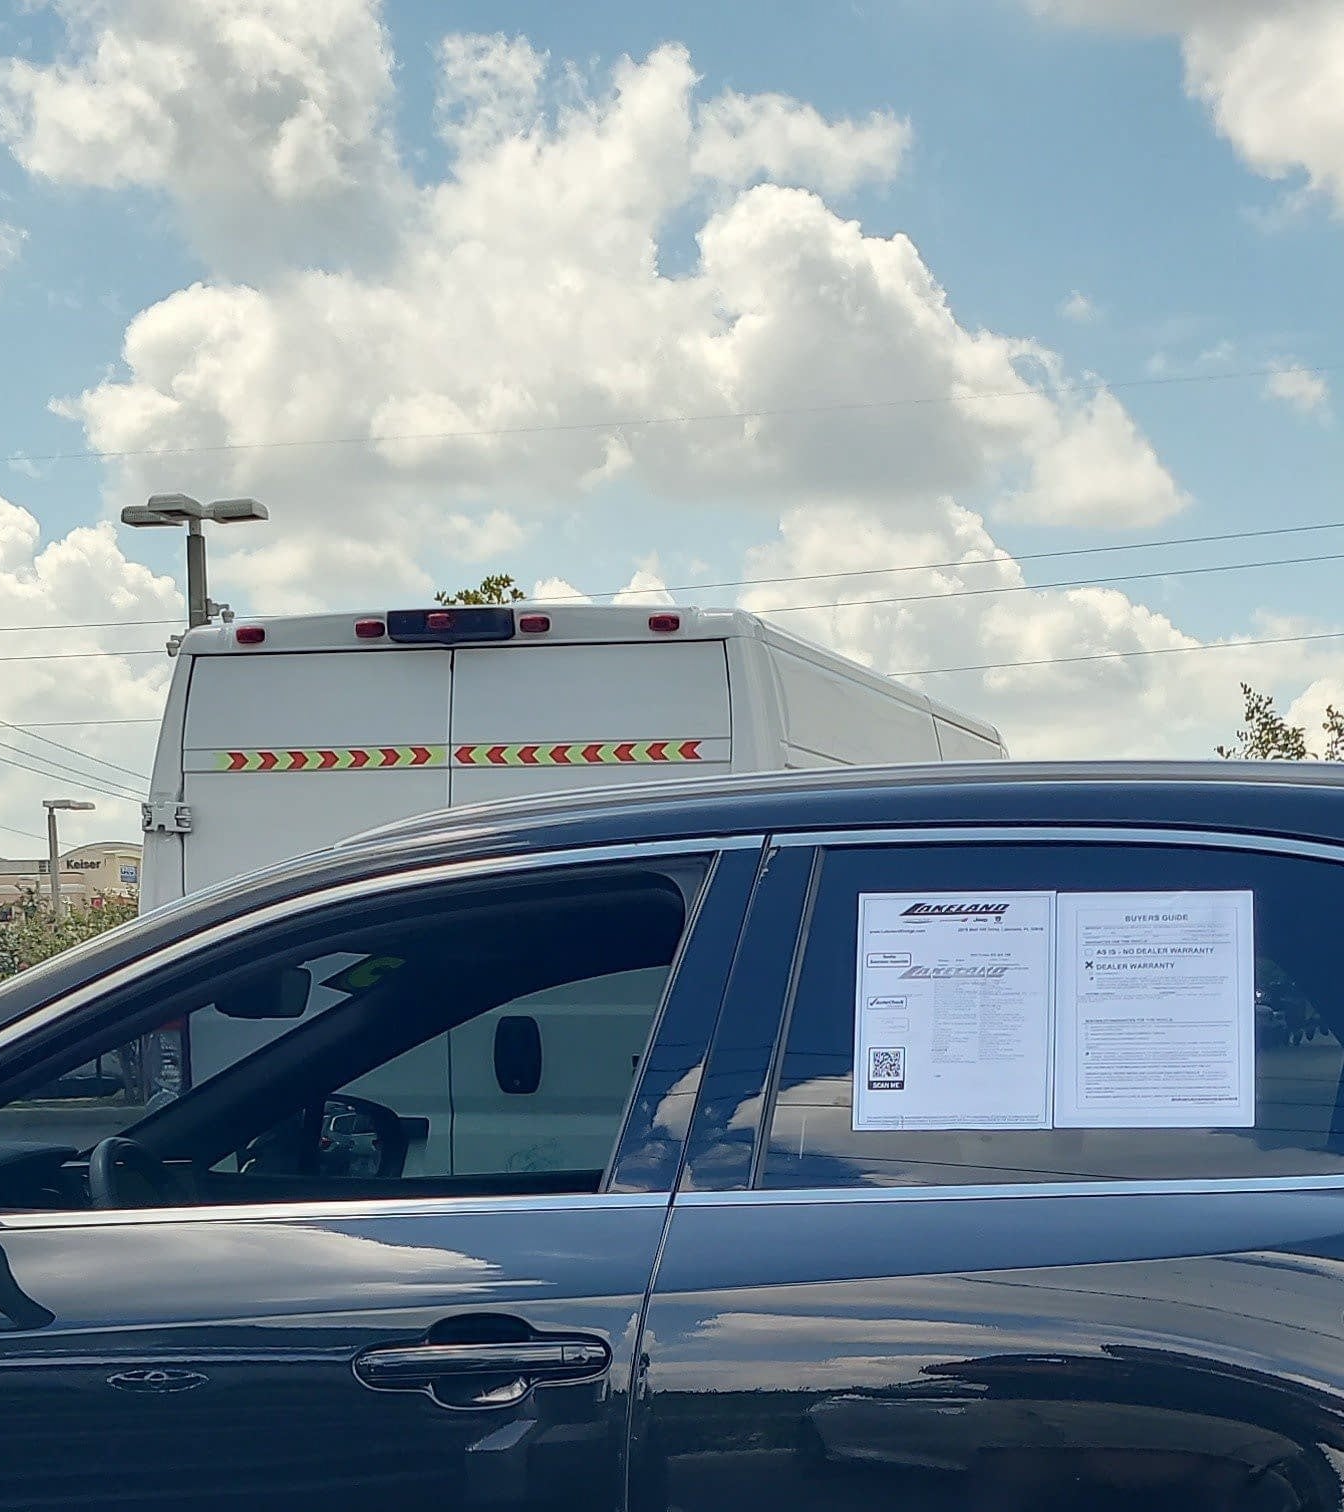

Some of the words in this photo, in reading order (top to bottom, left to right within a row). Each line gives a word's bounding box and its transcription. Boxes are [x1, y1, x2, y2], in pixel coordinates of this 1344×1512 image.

[66, 860, 102, 870] Keiser
[899, 903, 1010, 917] LAKELAND
[1125, 915, 1159, 923] BUYERS
[1162, 914, 1189, 922] GUIDE
[1136, 947, 1168, 955] DEALER
[1169, 946, 1215, 954] WARRANTY
[1096, 963, 1128, 971] DEALER
[1129, 962, 1175, 970] WARRANTY
